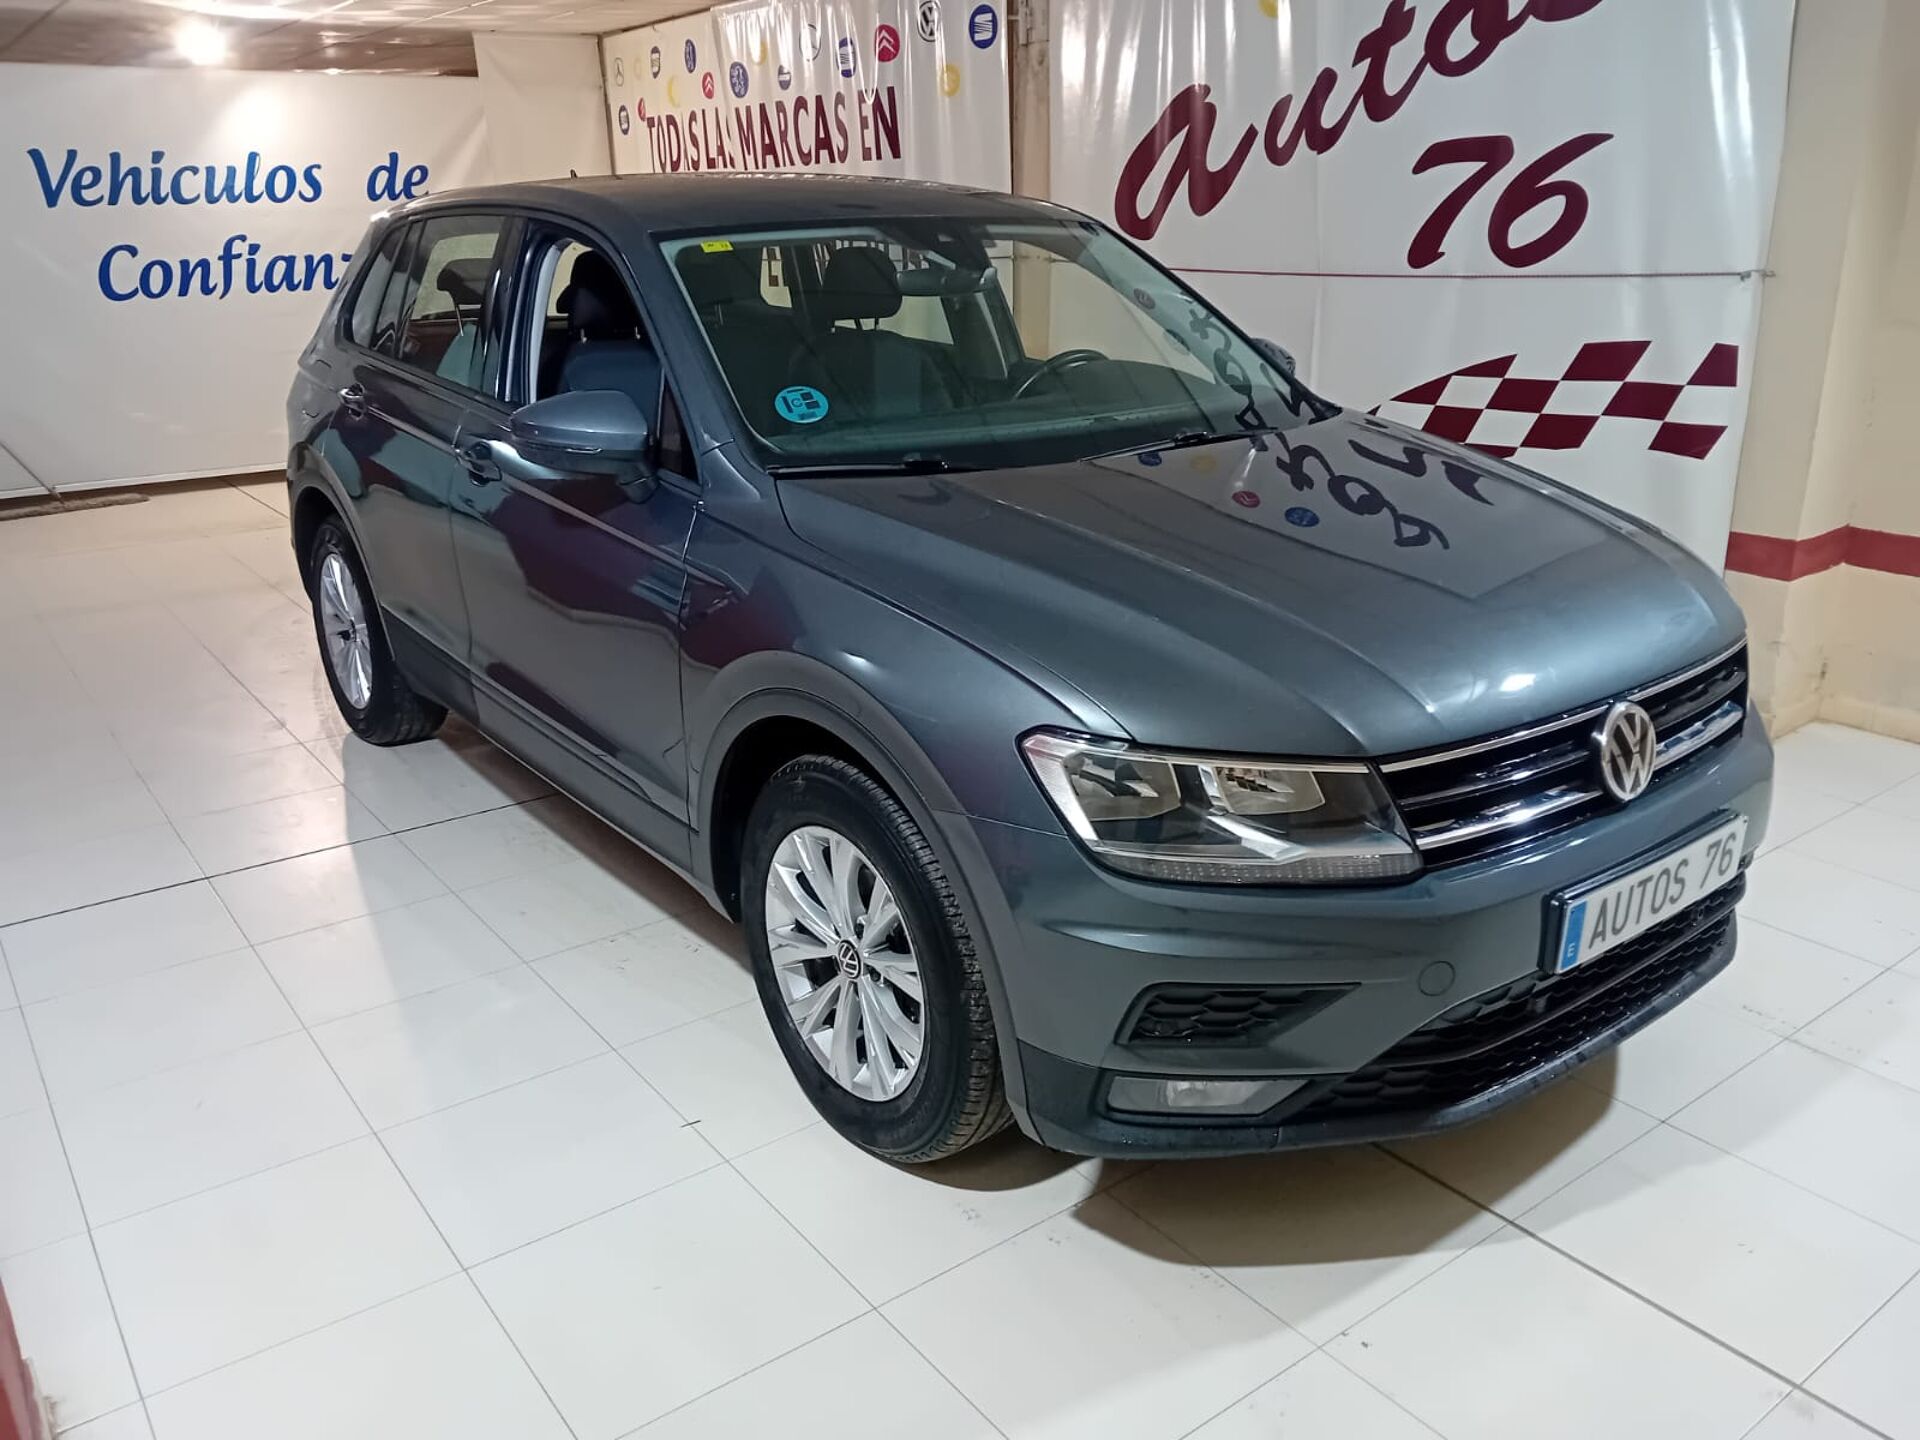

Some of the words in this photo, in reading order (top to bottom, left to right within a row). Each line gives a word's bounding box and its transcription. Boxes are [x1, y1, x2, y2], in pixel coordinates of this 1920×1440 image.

[735, 91, 849, 171] MARCAS
[858, 86, 901, 161] EN
[367, 152, 429, 201] de
[1407, 133, 1613, 268] 76
[98, 234, 352, 302] Confian
[1589, 858, 1689, 949] AUTOS
[1700, 832, 1736, 889] 76
